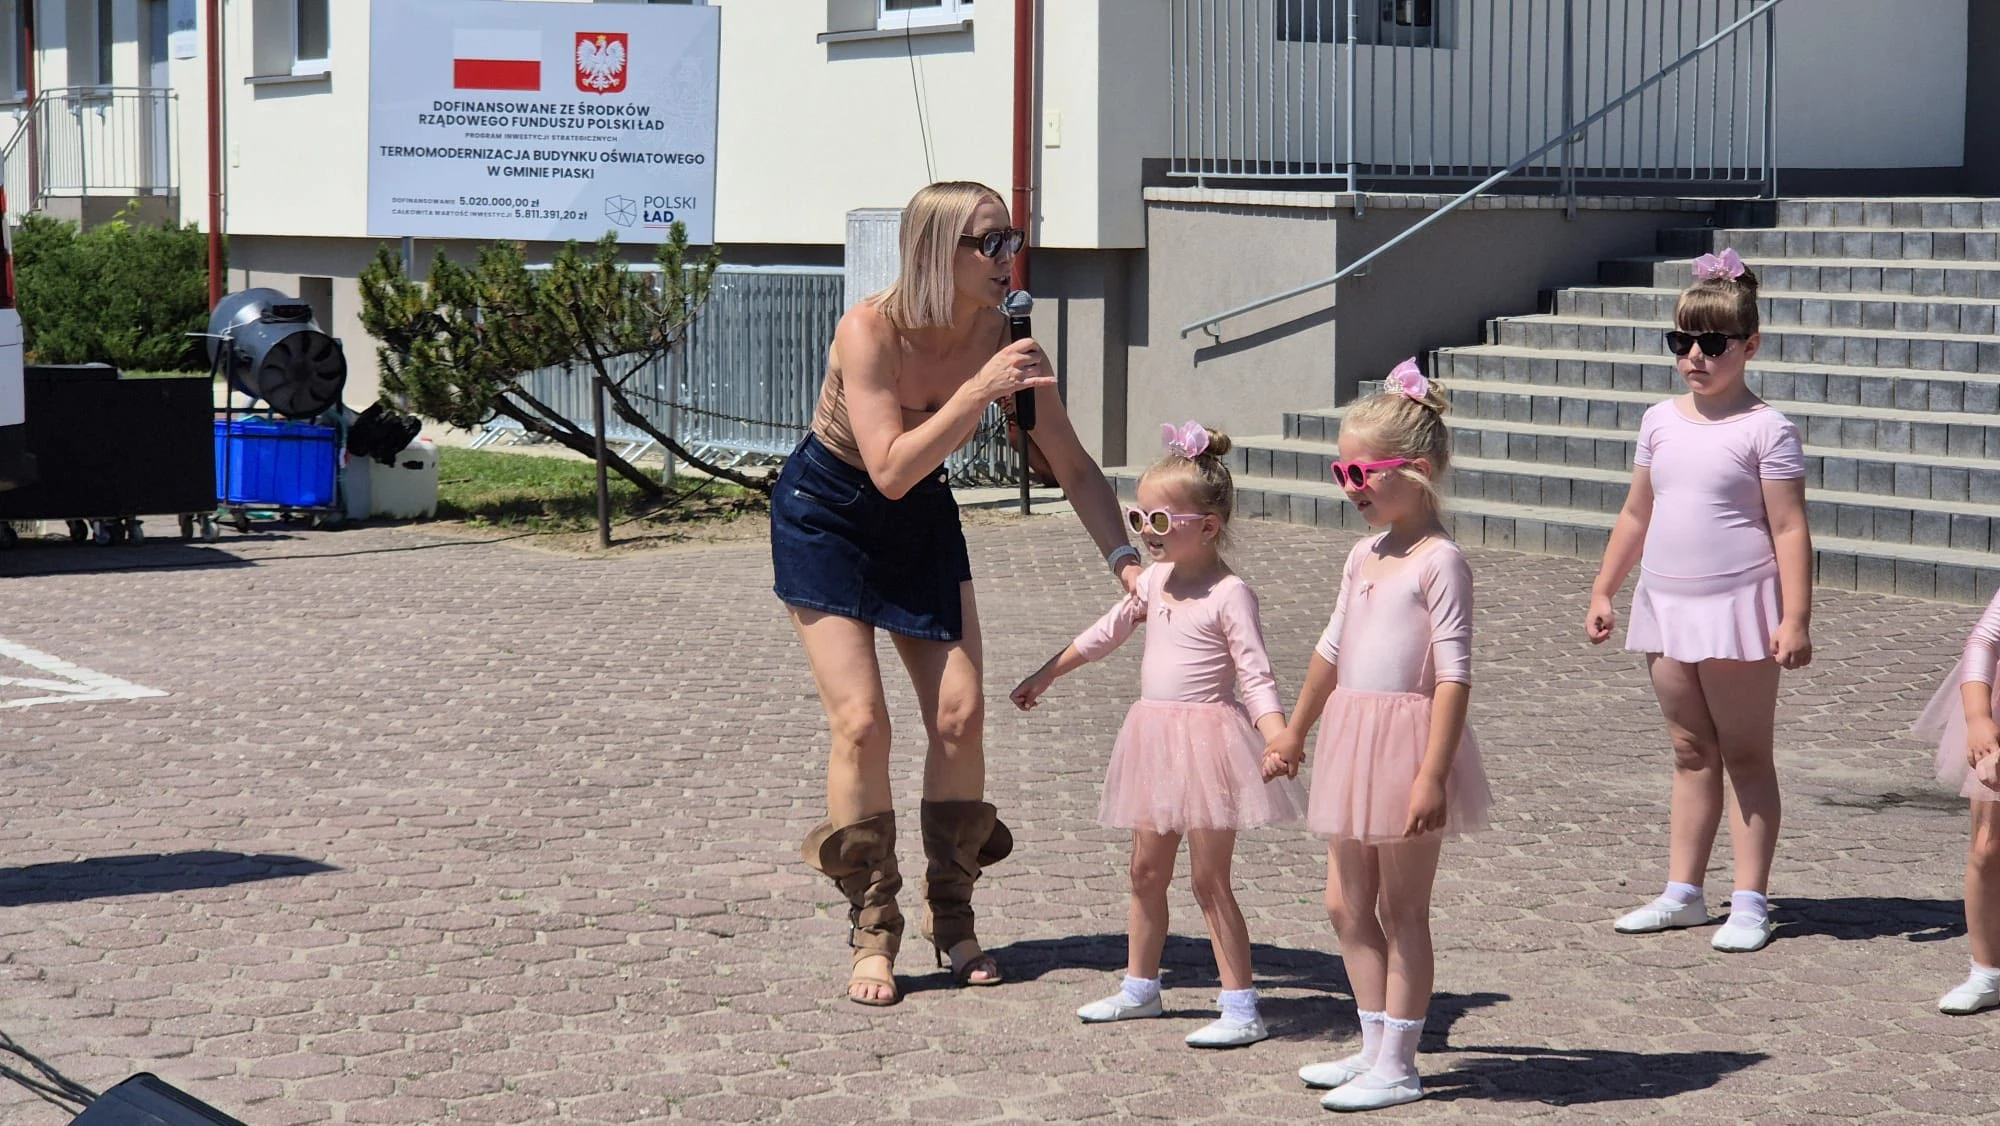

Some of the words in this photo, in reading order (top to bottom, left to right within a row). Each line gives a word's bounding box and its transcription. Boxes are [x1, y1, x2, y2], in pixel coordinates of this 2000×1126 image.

[433, 100, 557, 115] DOFINANSOWANE
[560, 104, 575, 115] ZE
[578, 101, 650, 116] ŚRODKÓW
[418, 114, 509, 128] RZĄDOWEGO
[512, 116, 585, 129] FUNDUSZU
[587, 118, 635, 130] POLSKI
[638, 119, 665, 131] ŁAD
[504, 133, 550, 141] INWESTYCJI
[551, 134, 618, 142] STRATEGICZNYCH
[379, 145, 531, 161] TERMOMODERNIZACJA
[533, 149, 597, 162] BUDYNKU
[600, 149, 705, 165] OŚWIATOWEGO
[487, 165, 500, 177] W
[503, 165, 549, 178] GMINIE
[552, 167, 594, 179] PIASKI
[459, 196, 529, 208] 5.020.000,00
[530, 198, 540, 208] zł
[643, 195, 697, 210] POLSKI
[514, 209, 577, 221] 5.811.391,20
[578, 210, 588, 220] zł
[643, 210, 675, 223] ŁAD
